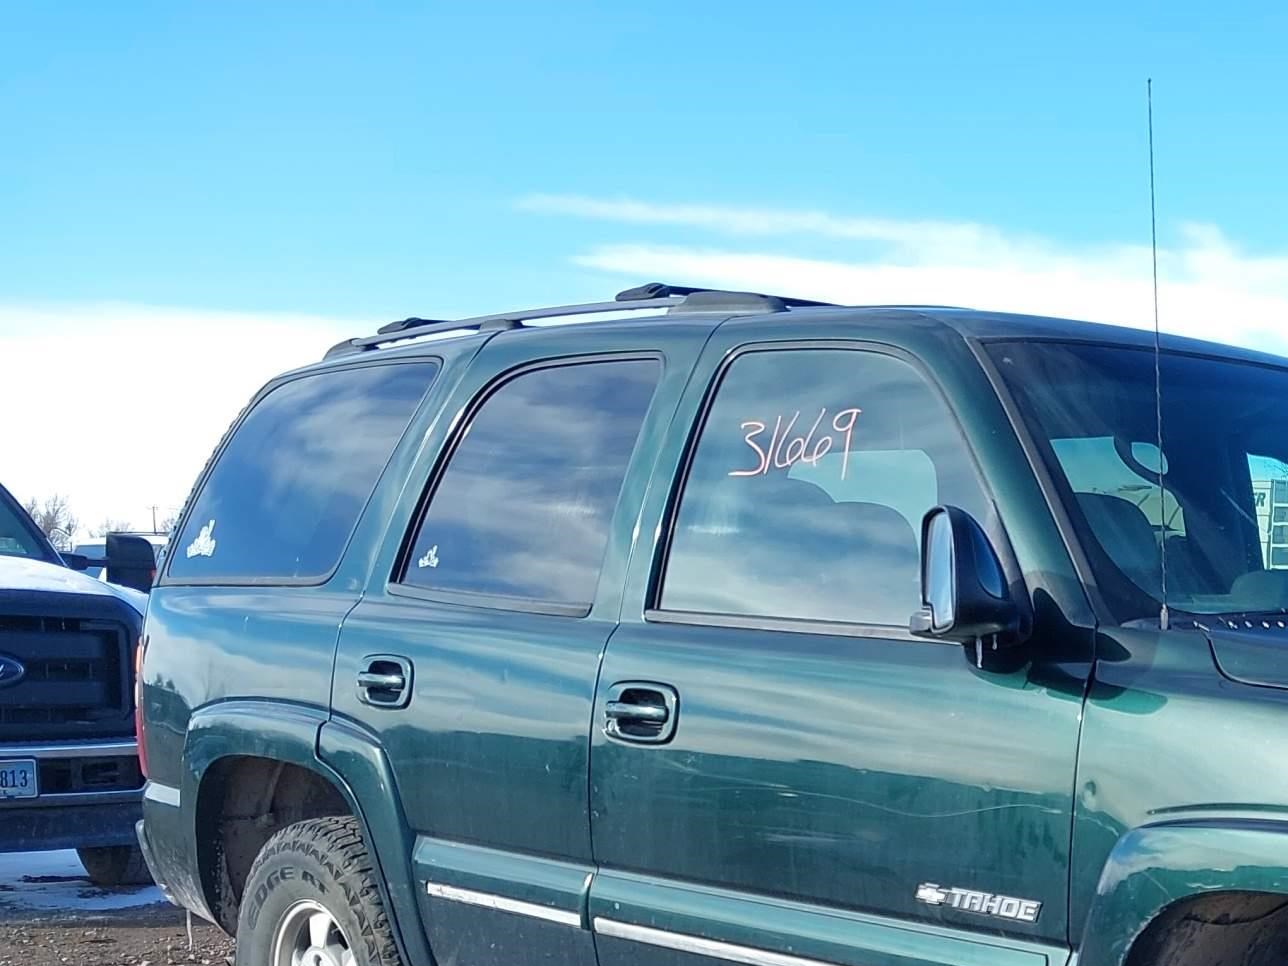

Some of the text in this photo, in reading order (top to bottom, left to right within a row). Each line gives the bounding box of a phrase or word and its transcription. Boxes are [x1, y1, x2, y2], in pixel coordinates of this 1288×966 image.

[727, 407, 862, 480] 31669
[0, 769, 28, 788] 813
[951, 887, 1042, 923] TAHOE
